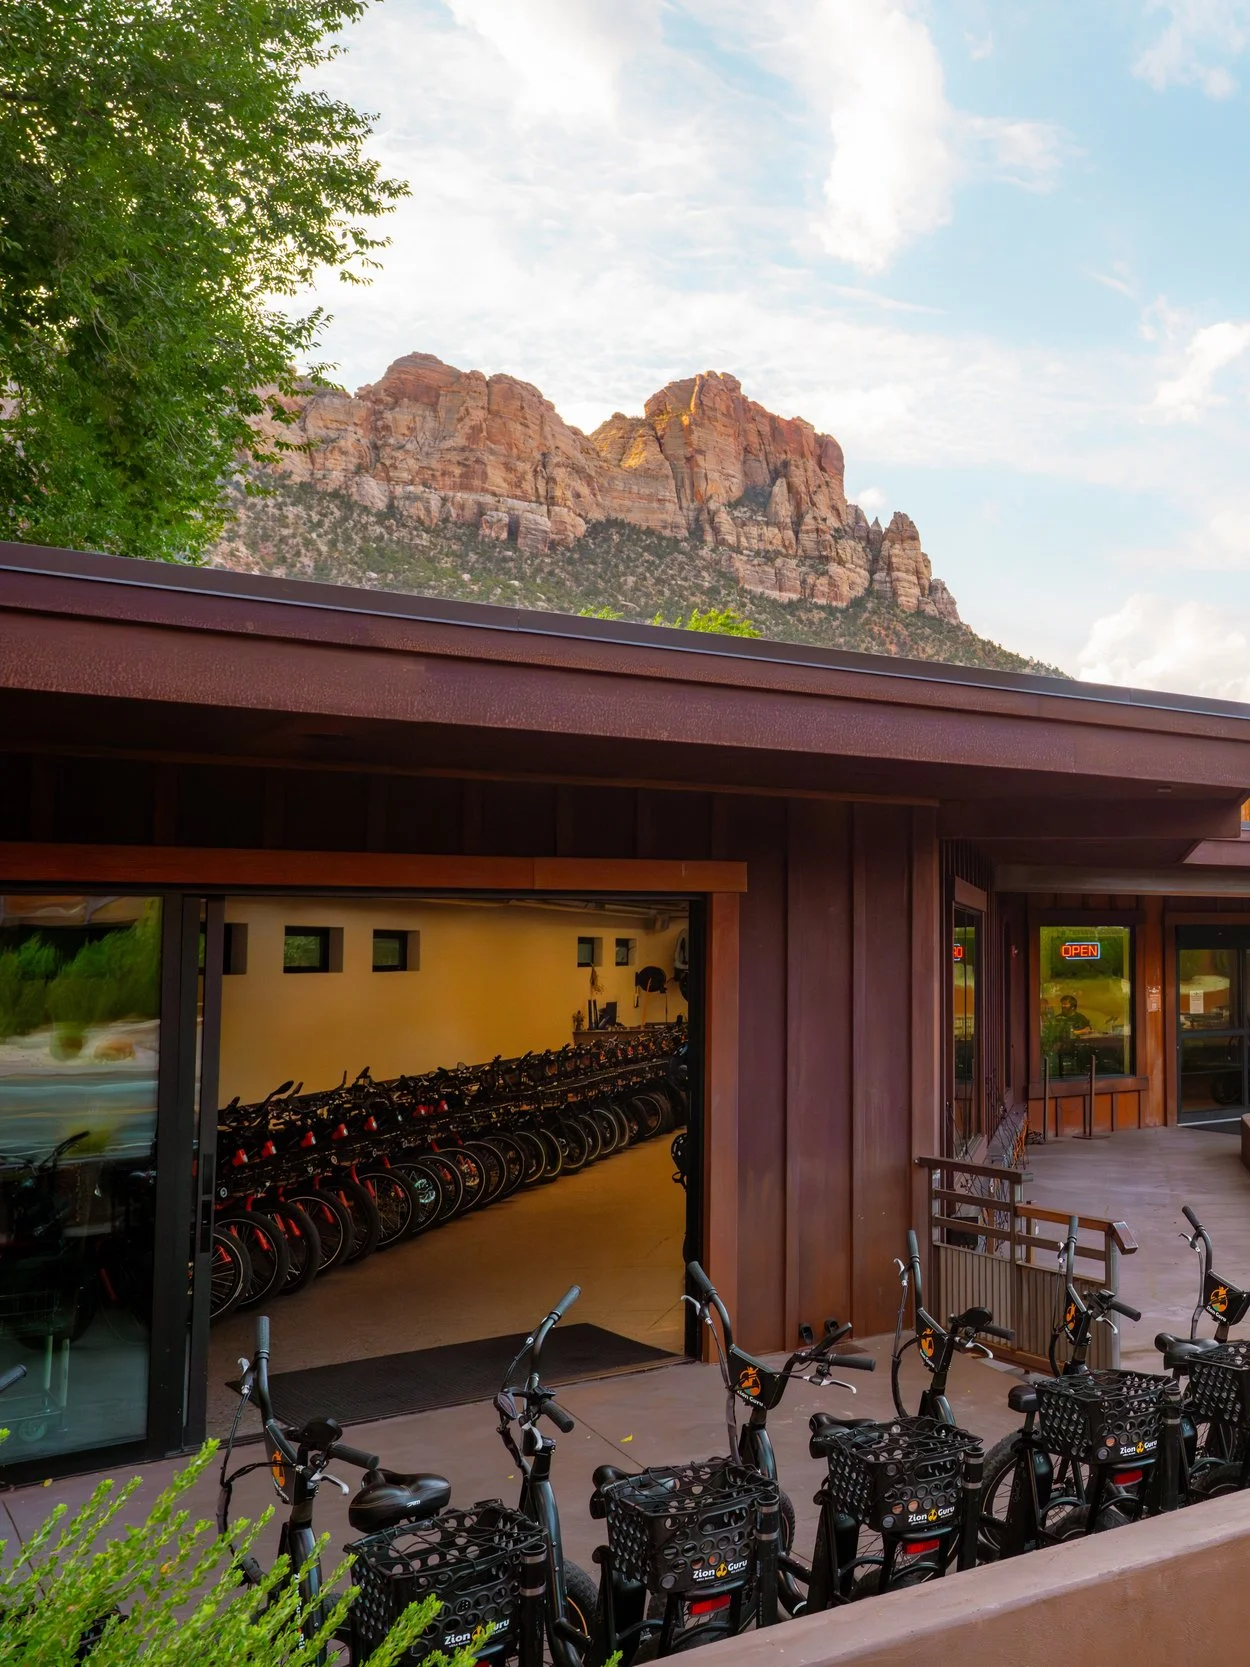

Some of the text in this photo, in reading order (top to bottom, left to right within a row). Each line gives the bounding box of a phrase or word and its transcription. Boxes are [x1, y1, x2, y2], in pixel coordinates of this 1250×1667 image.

[1061, 945, 1098, 957] OPEN
[1120, 1446, 1136, 1454] Zion
[1144, 1440, 1157, 1449] Guru
[908, 1513, 927, 1523] Zion
[937, 1506, 955, 1516] Guru
[692, 1569, 715, 1579] Zion
[727, 1559, 748, 1571] Guru
[444, 1632, 471, 1646] Zion
